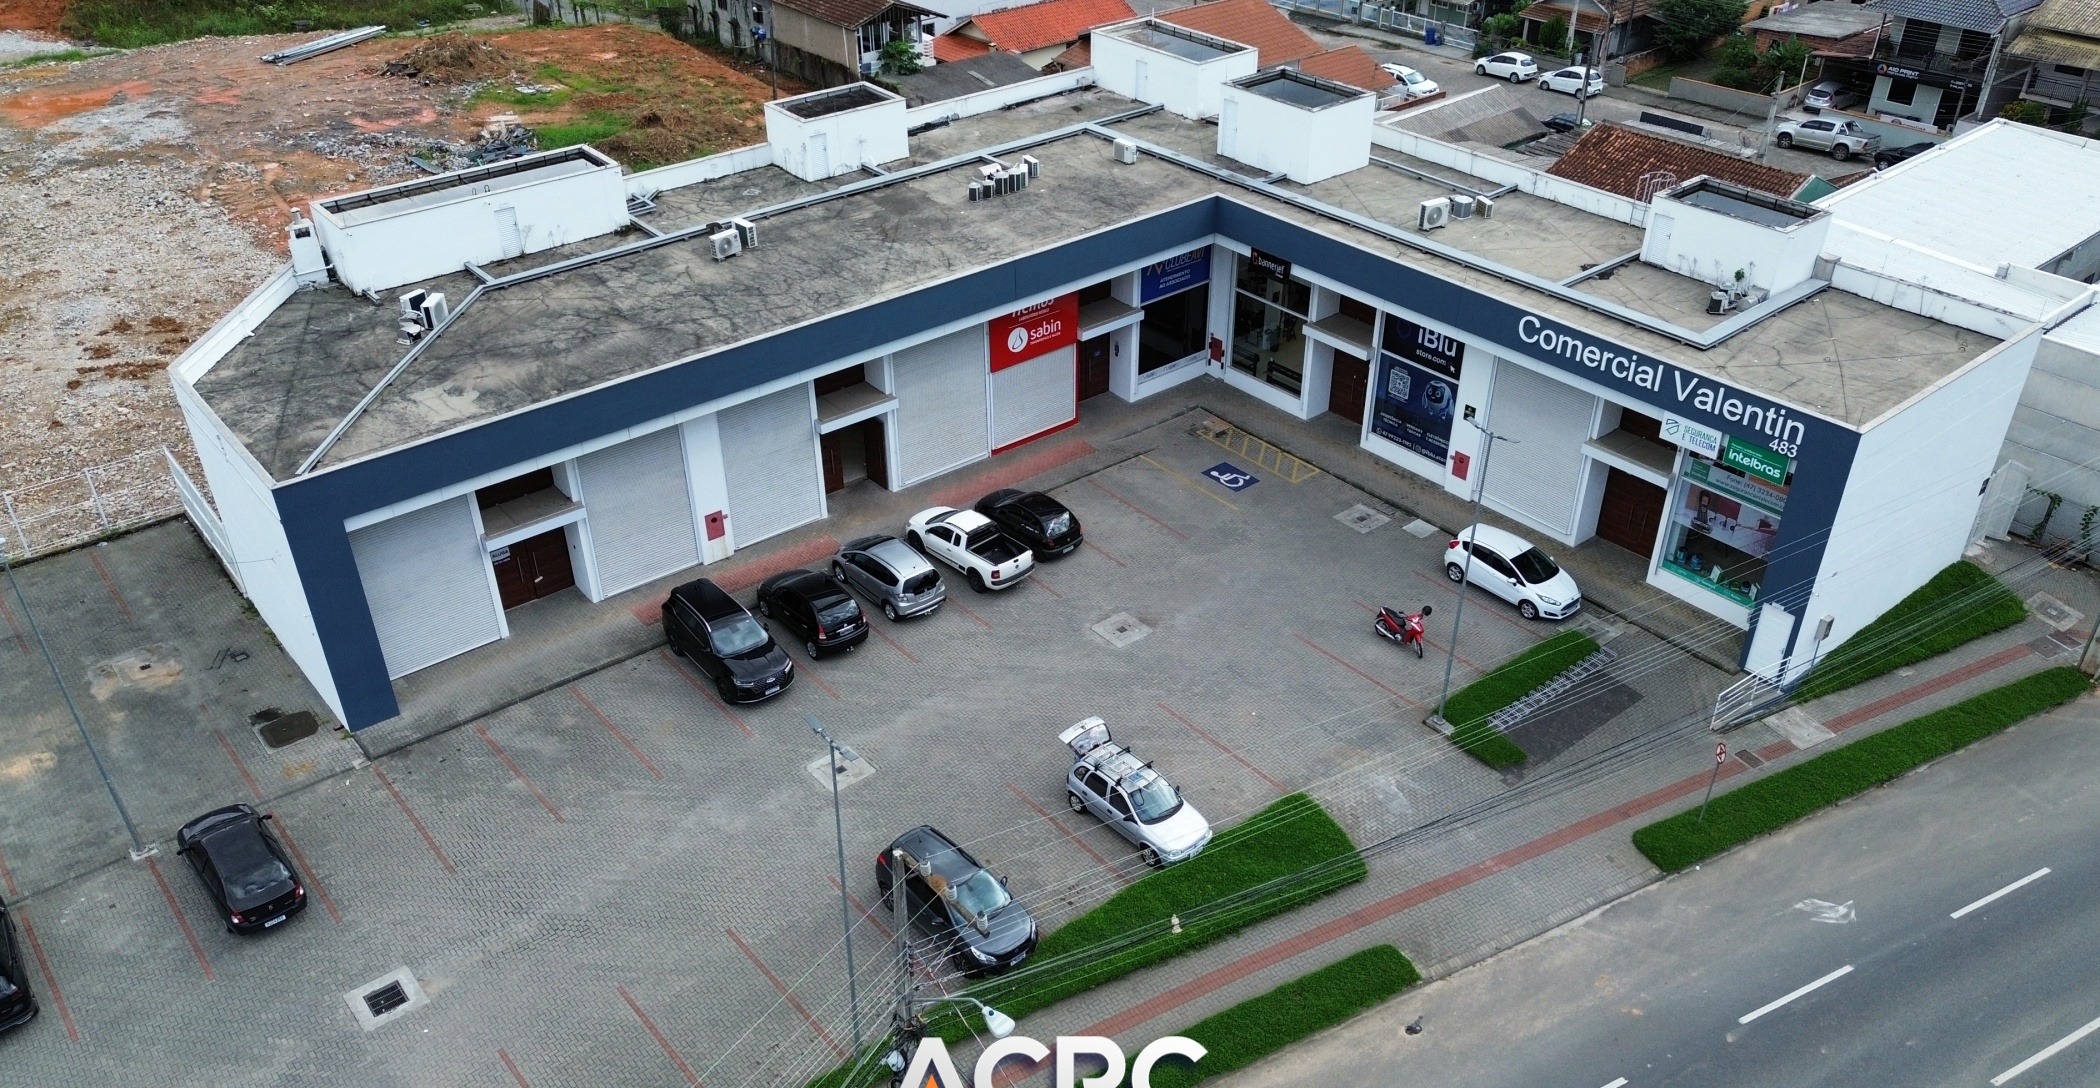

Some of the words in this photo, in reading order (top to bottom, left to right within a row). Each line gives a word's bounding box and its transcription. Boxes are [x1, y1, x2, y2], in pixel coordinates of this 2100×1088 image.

[1900, 68, 1920, 77] PRINT
[1029, 319, 1062, 340] sabin
[1415, 348, 1447, 366] store.com
[1518, 315, 1665, 392] Comercial
[1674, 371, 1805, 445] Valentin
[1681, 433, 1686, 441] E
[1688, 435, 1716, 453] TELECOM
[1768, 438, 1798, 458] 483
[1728, 448, 1781, 478] intelbras
